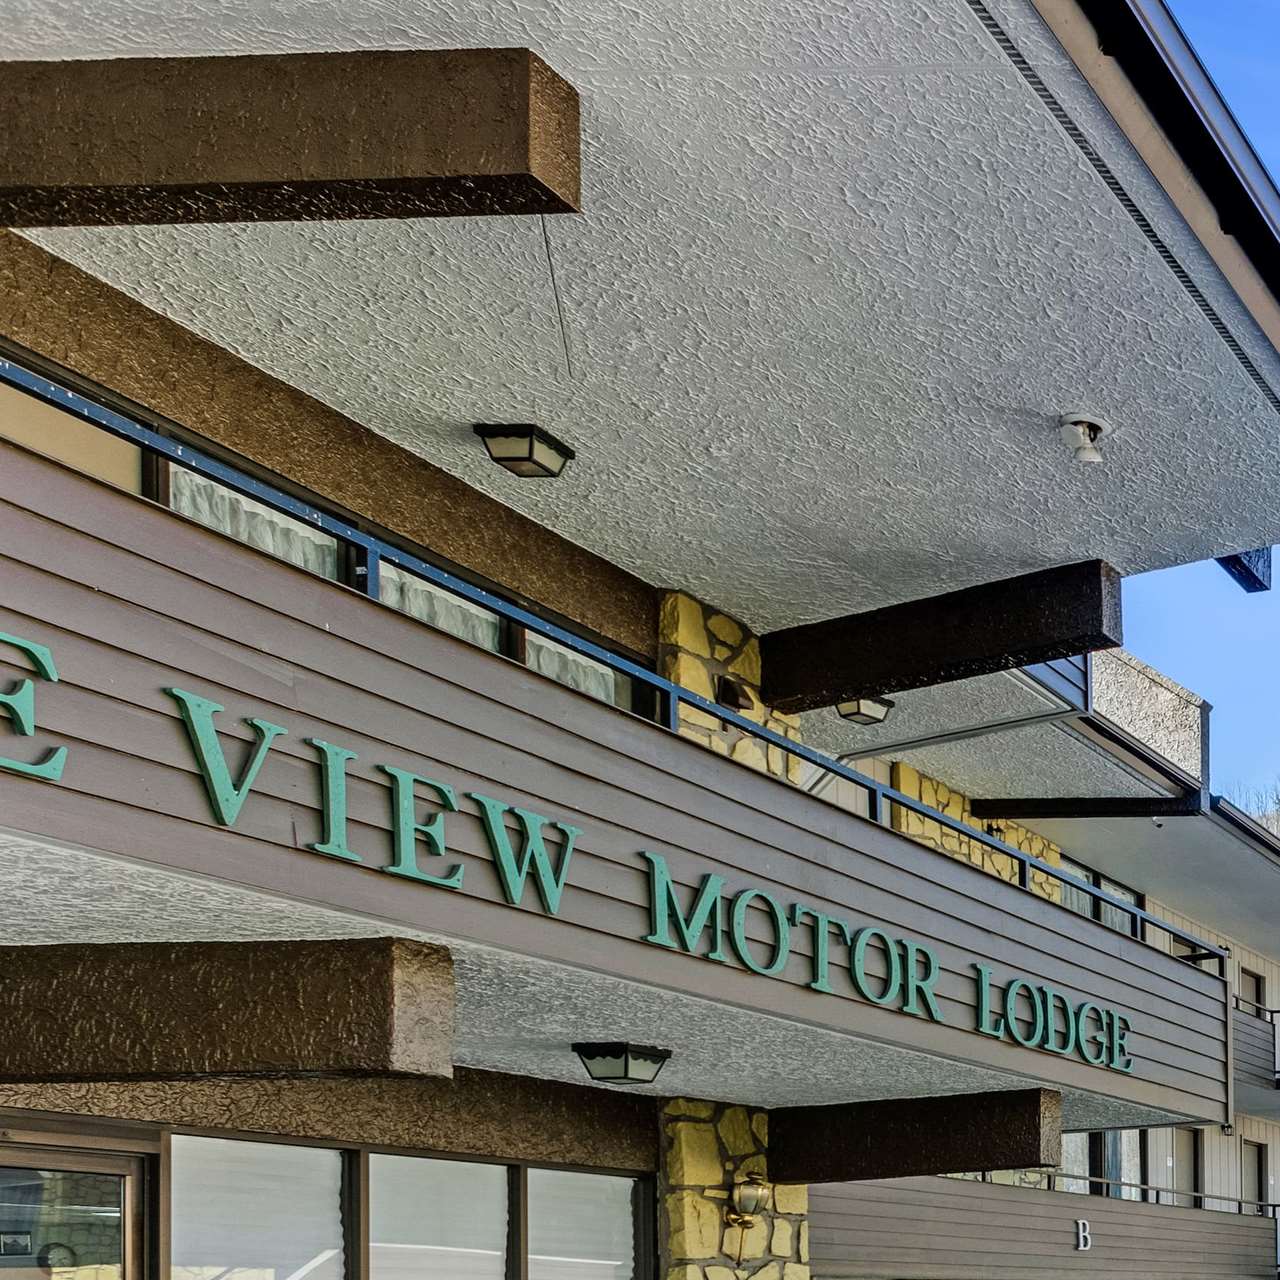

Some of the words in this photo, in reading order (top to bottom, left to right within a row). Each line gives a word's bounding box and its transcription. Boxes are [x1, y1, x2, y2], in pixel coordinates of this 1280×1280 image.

[161, 686, 585, 915] VIEW
[641, 850, 944, 1022] MOTOR
[973, 963, 1134, 1074] LODGE
[1075, 1219, 1092, 1251] B
